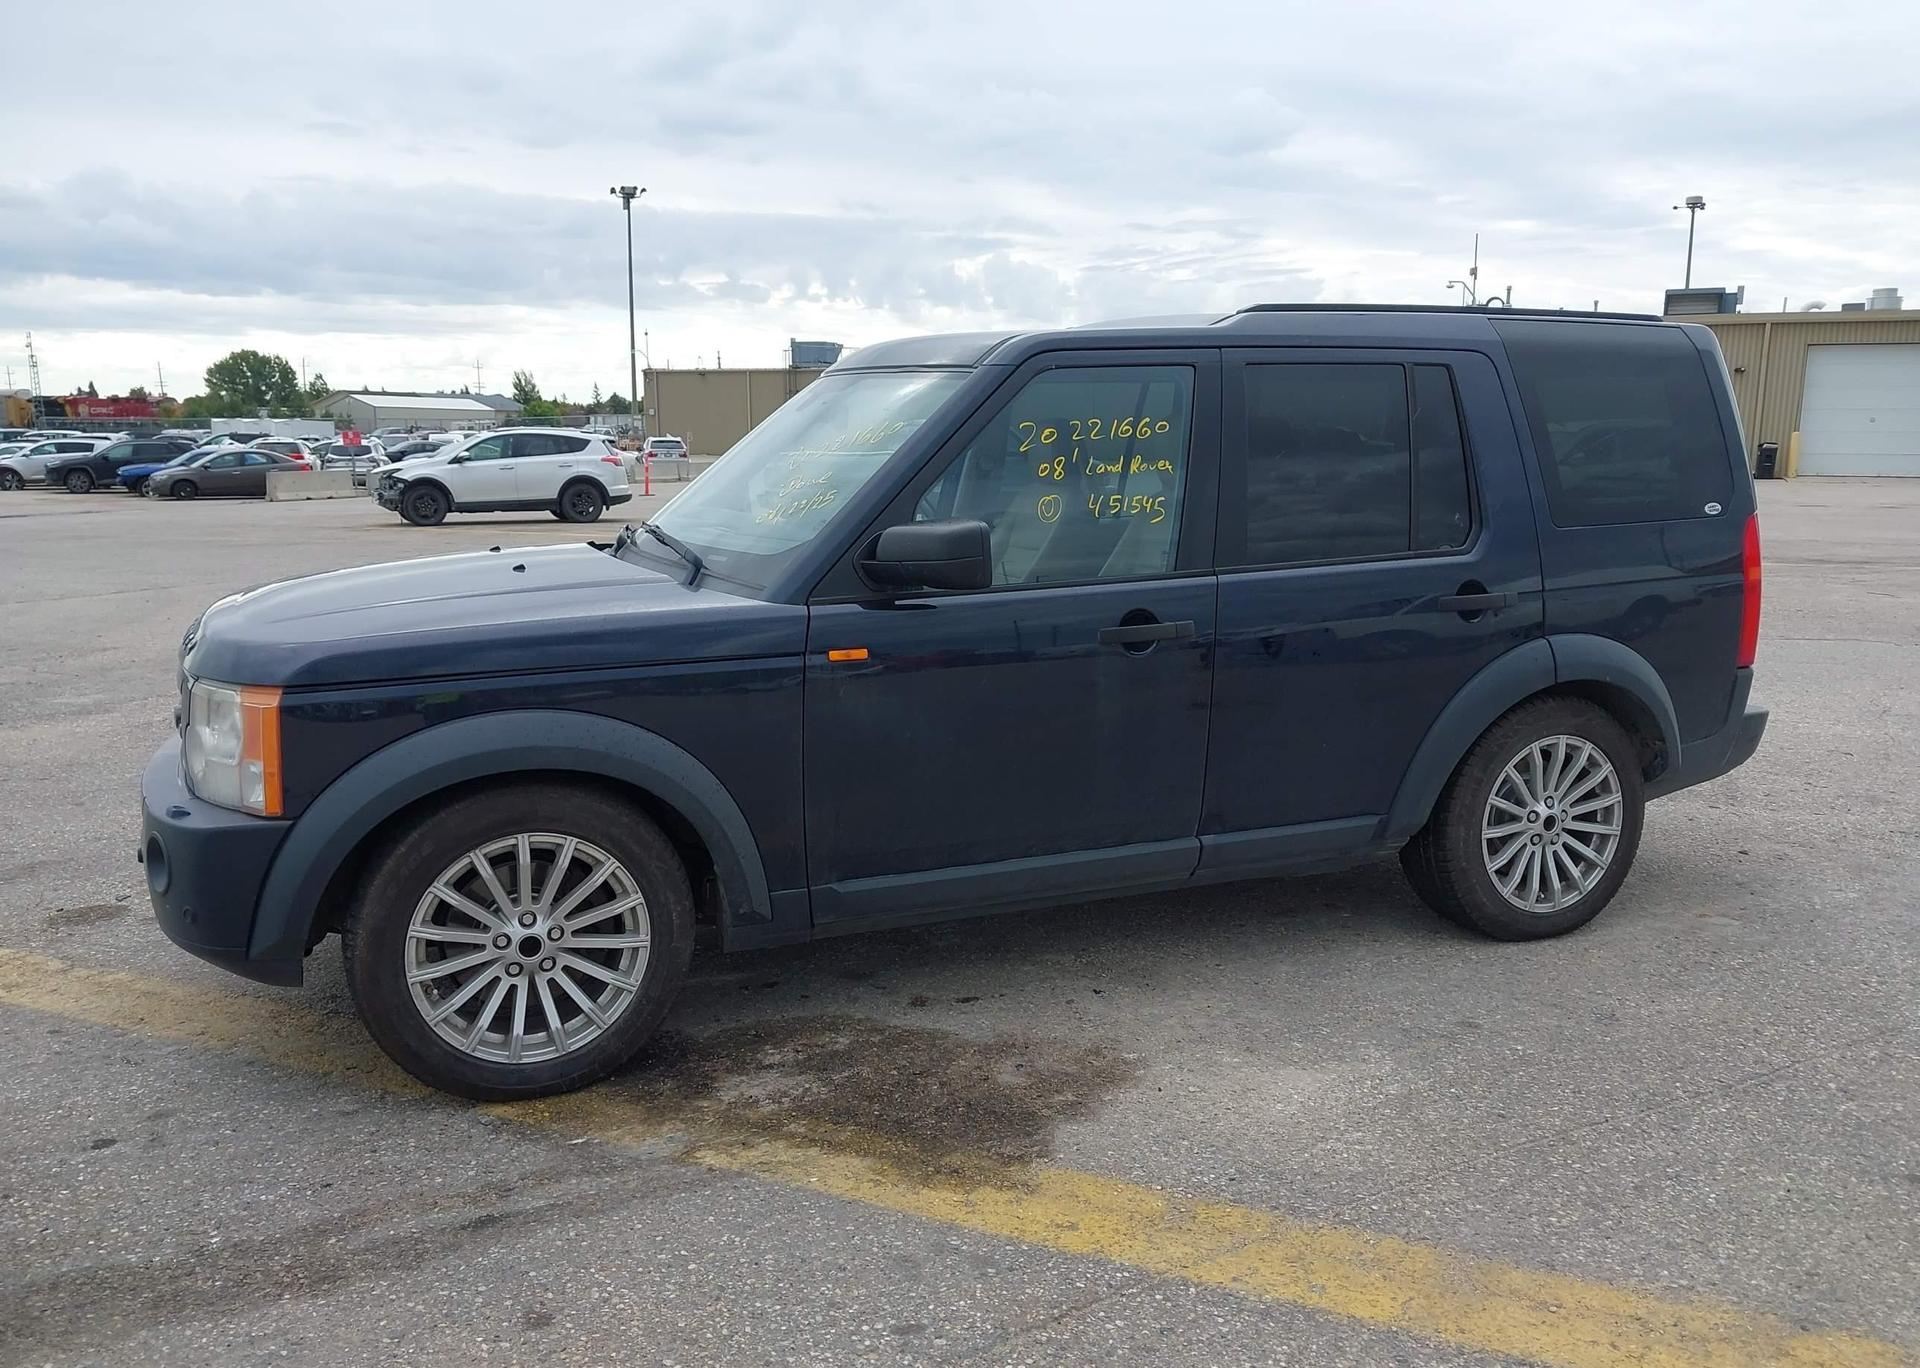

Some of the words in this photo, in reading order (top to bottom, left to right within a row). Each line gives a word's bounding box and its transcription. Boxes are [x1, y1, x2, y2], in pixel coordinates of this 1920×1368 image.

[1019, 421, 1057, 452] 20
[1069, 417, 1170, 440] 221660
[1086, 455, 1124, 475] Land
[1088, 493, 1166, 524] 451545
